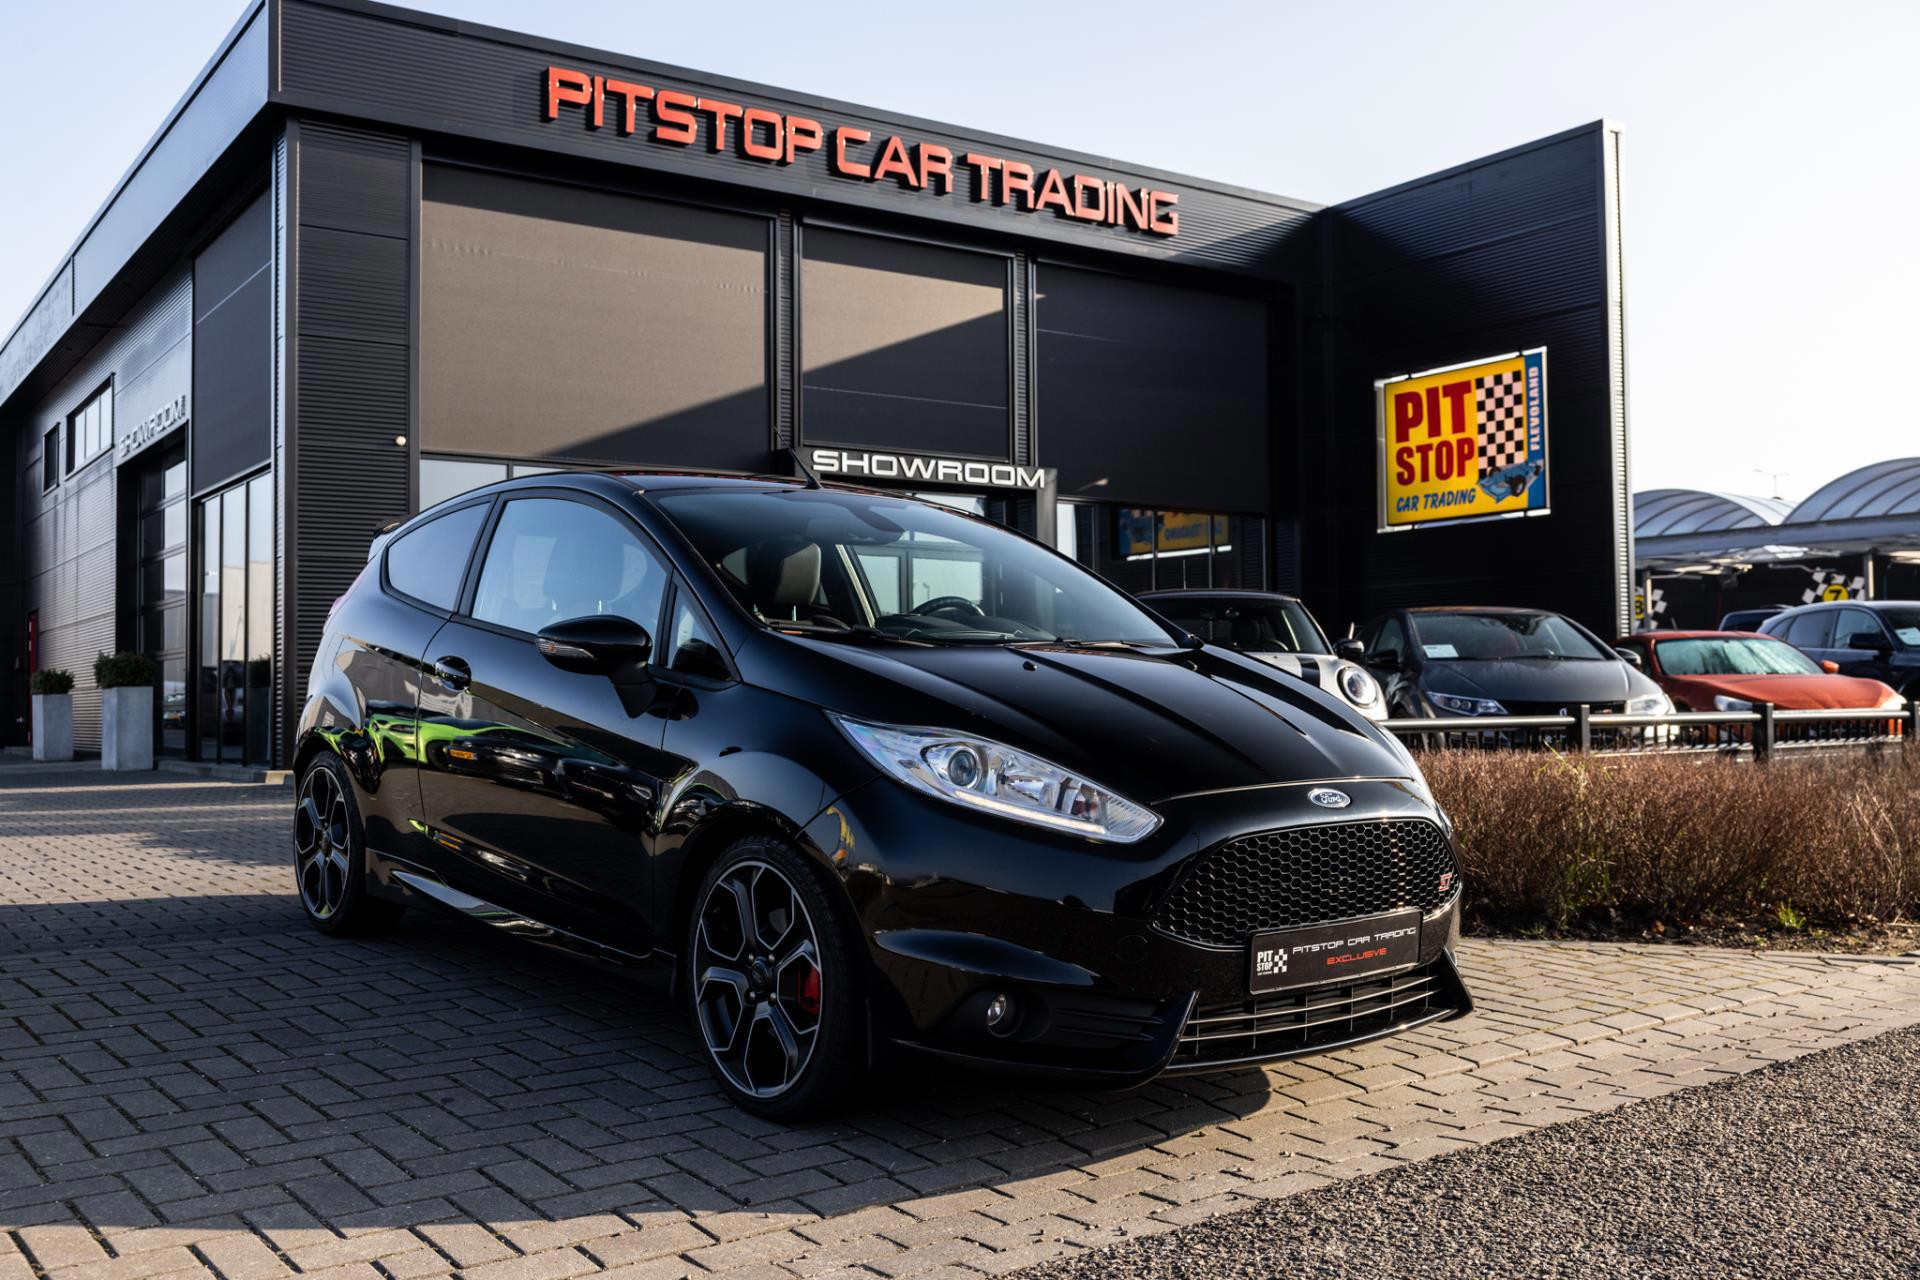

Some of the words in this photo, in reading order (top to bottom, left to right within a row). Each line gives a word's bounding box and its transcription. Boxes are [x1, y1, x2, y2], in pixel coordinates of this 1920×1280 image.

[547, 66, 823, 164] PITSTOP
[835, 125, 953, 193] CAR
[960, 151, 1180, 236] TRADING
[1394, 380, 1473, 443] PIT
[1527, 366, 1541, 451] FLEVOLAND
[119, 395, 186, 458] SHOWROOM
[812, 449, 1046, 488] SHOWROOM
[1396, 437, 1475, 486] STOP
[1396, 496, 1420, 512] CAR
[1423, 488, 1477, 510] TRADING
[1828, 588, 1843, 601] 7
[1320, 792, 1343, 804] Ford
[1292, 939, 1345, 955] PITSTOP
[1347, 935, 1371, 948] CAR
[1374, 926, 1417, 942] TRADING
[1256, 961, 1273, 971] STOP
[1257, 950, 1274, 963] PIT
[1326, 947, 1389, 966] EXCLUSIVE
